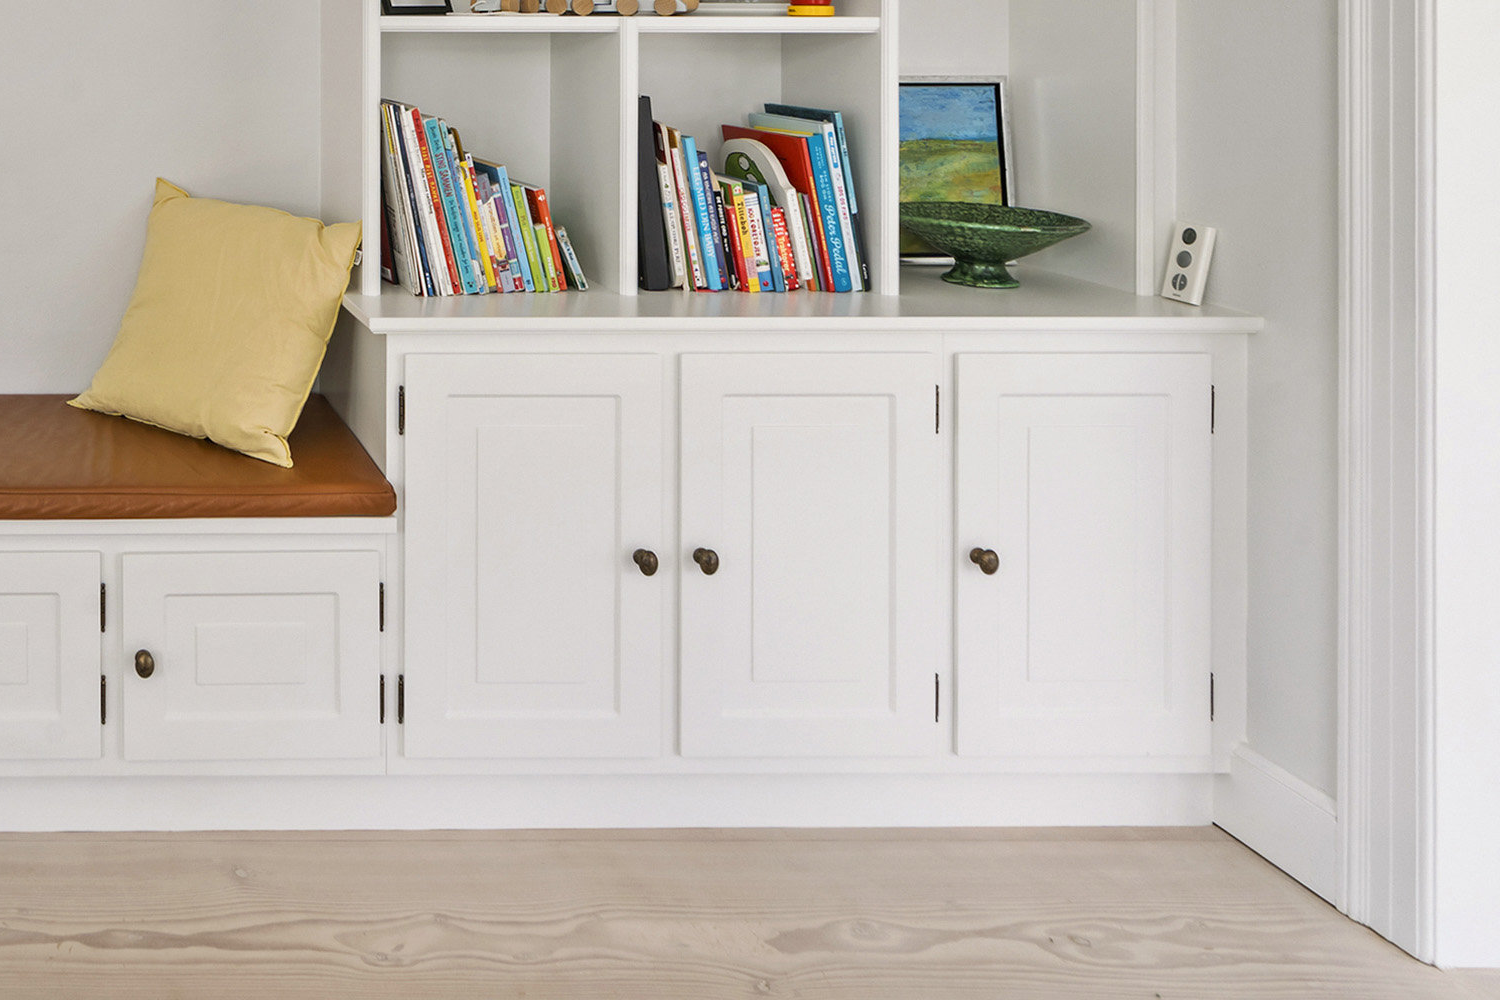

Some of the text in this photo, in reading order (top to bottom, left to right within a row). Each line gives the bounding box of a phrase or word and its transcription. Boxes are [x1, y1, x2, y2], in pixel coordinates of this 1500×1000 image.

[693, 166, 703, 187] LEG
[696, 187, 707, 210] MED
[700, 211, 711, 232] DIN
[704, 233, 716, 258] BABY
[748, 219, 762, 258] KØRETØJER
[822, 204, 847, 275] Peter Pedal
[777, 236, 791, 272] Traktorer
